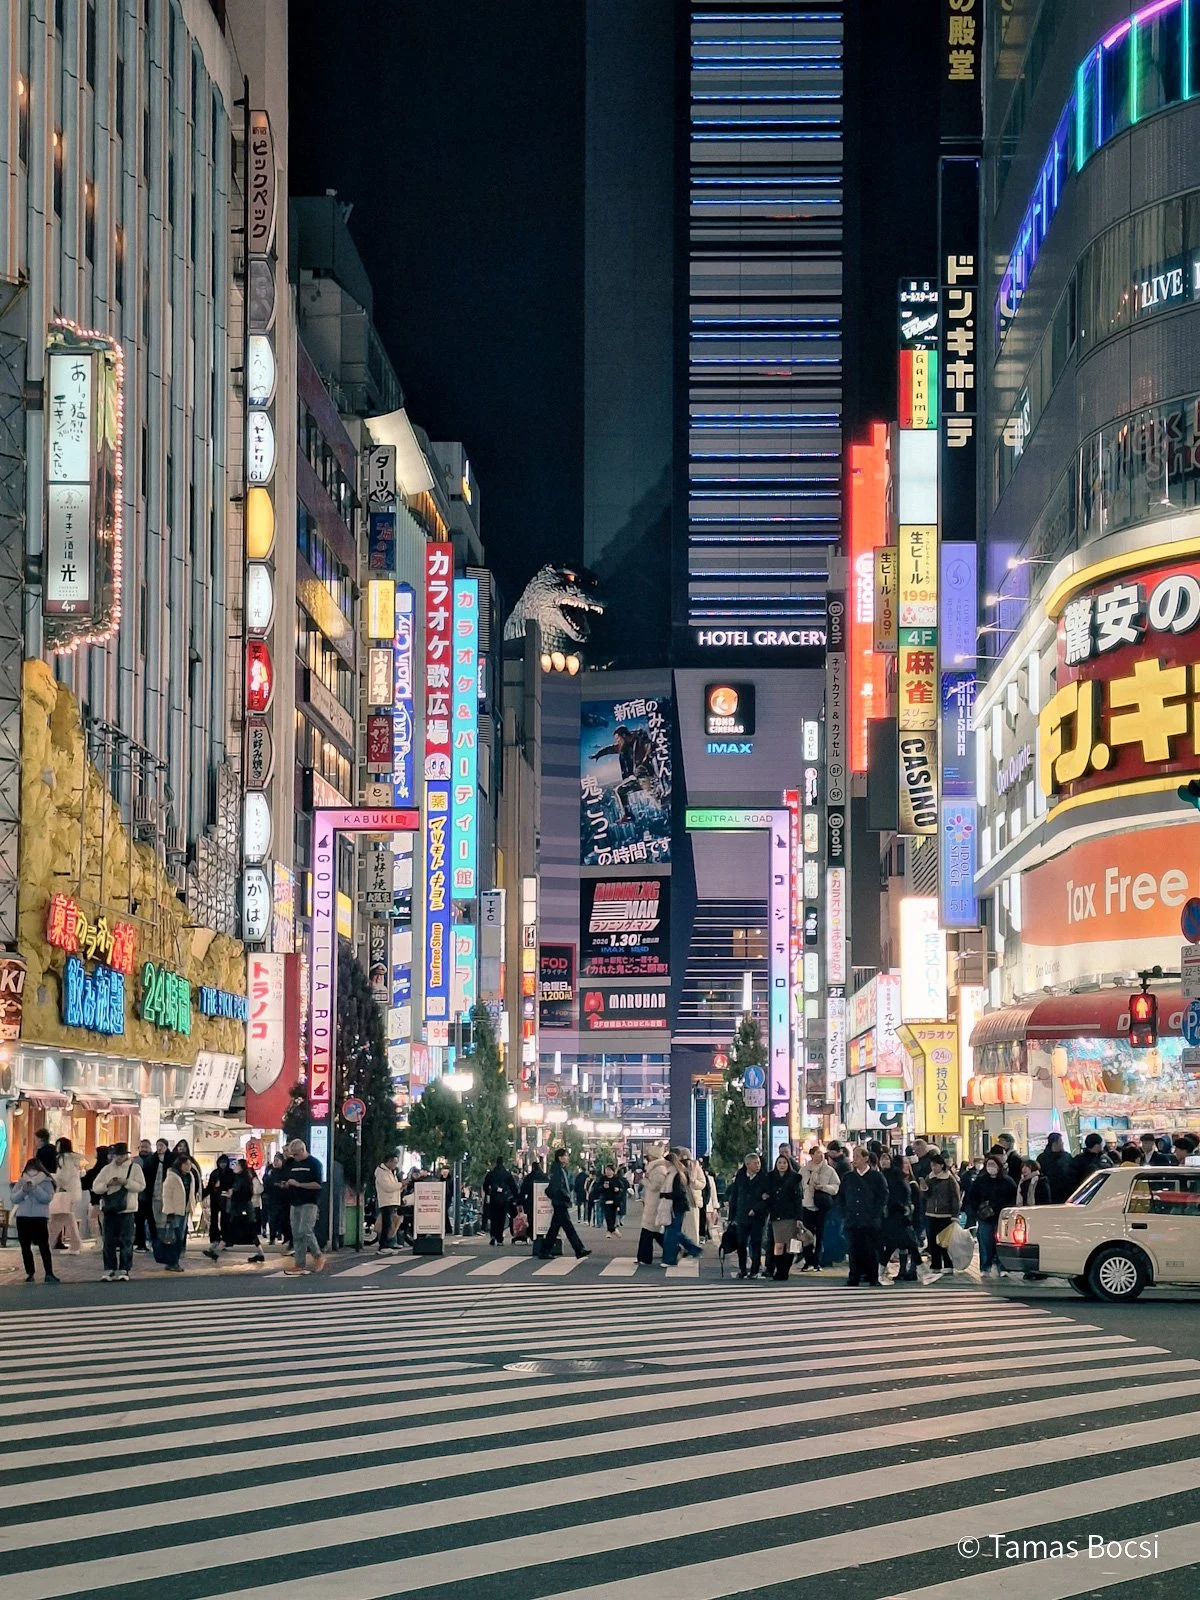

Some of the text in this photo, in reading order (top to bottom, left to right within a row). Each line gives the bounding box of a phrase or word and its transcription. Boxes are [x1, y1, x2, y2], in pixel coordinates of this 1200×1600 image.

[1141, 268, 1184, 308] LIVE
[914, 354, 927, 411] Garam
[376, 455, 390, 493] ダーツ
[60, 563, 77, 583] 光
[880, 552, 892, 596] 生ビール
[910, 531, 924, 586] 生ビール
[61, 600, 77, 613] 4F
[827, 600, 844, 645] Booth
[1064, 574, 1200, 666] 驚安の
[426, 550, 450, 745] カラオケ歌広場
[698, 631, 827, 646] HOTEL GRACERY
[907, 630, 934, 645] 4F
[905, 650, 935, 704] 麻雀
[709, 717, 735, 726] TOHO
[831, 658, 841, 758] ネットカフェ & カプセル
[902, 709, 930, 718] スリー
[614, 699, 672, 778] 新宿のみなさん
[706, 743, 753, 754] IMAX
[709, 725, 745, 734] CINEMAS
[431, 794, 446, 810] 薬
[900, 738, 938, 828] CASINO
[690, 815, 774, 823] CENTRAL ROAD
[827, 813, 844, 857] Booth
[950, 845, 970, 887] IDOL STAGE
[593, 881, 661, 901] RUNNING
[624, 900, 660, 919] MAN
[1066, 867, 1189, 925] Tax Free
[431, 923, 442, 947] Shop
[610, 933, 637, 947] 1.30
[312, 854, 331, 1074] GODZILLA ROAD
[431, 968, 442, 986] Tax
[540, 957, 569, 969] FOD
[774, 872, 788, 1058] ゴジラロード
[66, 957, 125, 1035] 飲み放題
[142, 961, 192, 1036] 24時間
[251, 961, 270, 1040] トラノコ
[608, 993, 666, 1009] MARUHAN
[829, 987, 844, 997] 2F
[917, 1030, 956, 1041] カラオケ
[935, 1067, 948, 1126] 持込OK!
